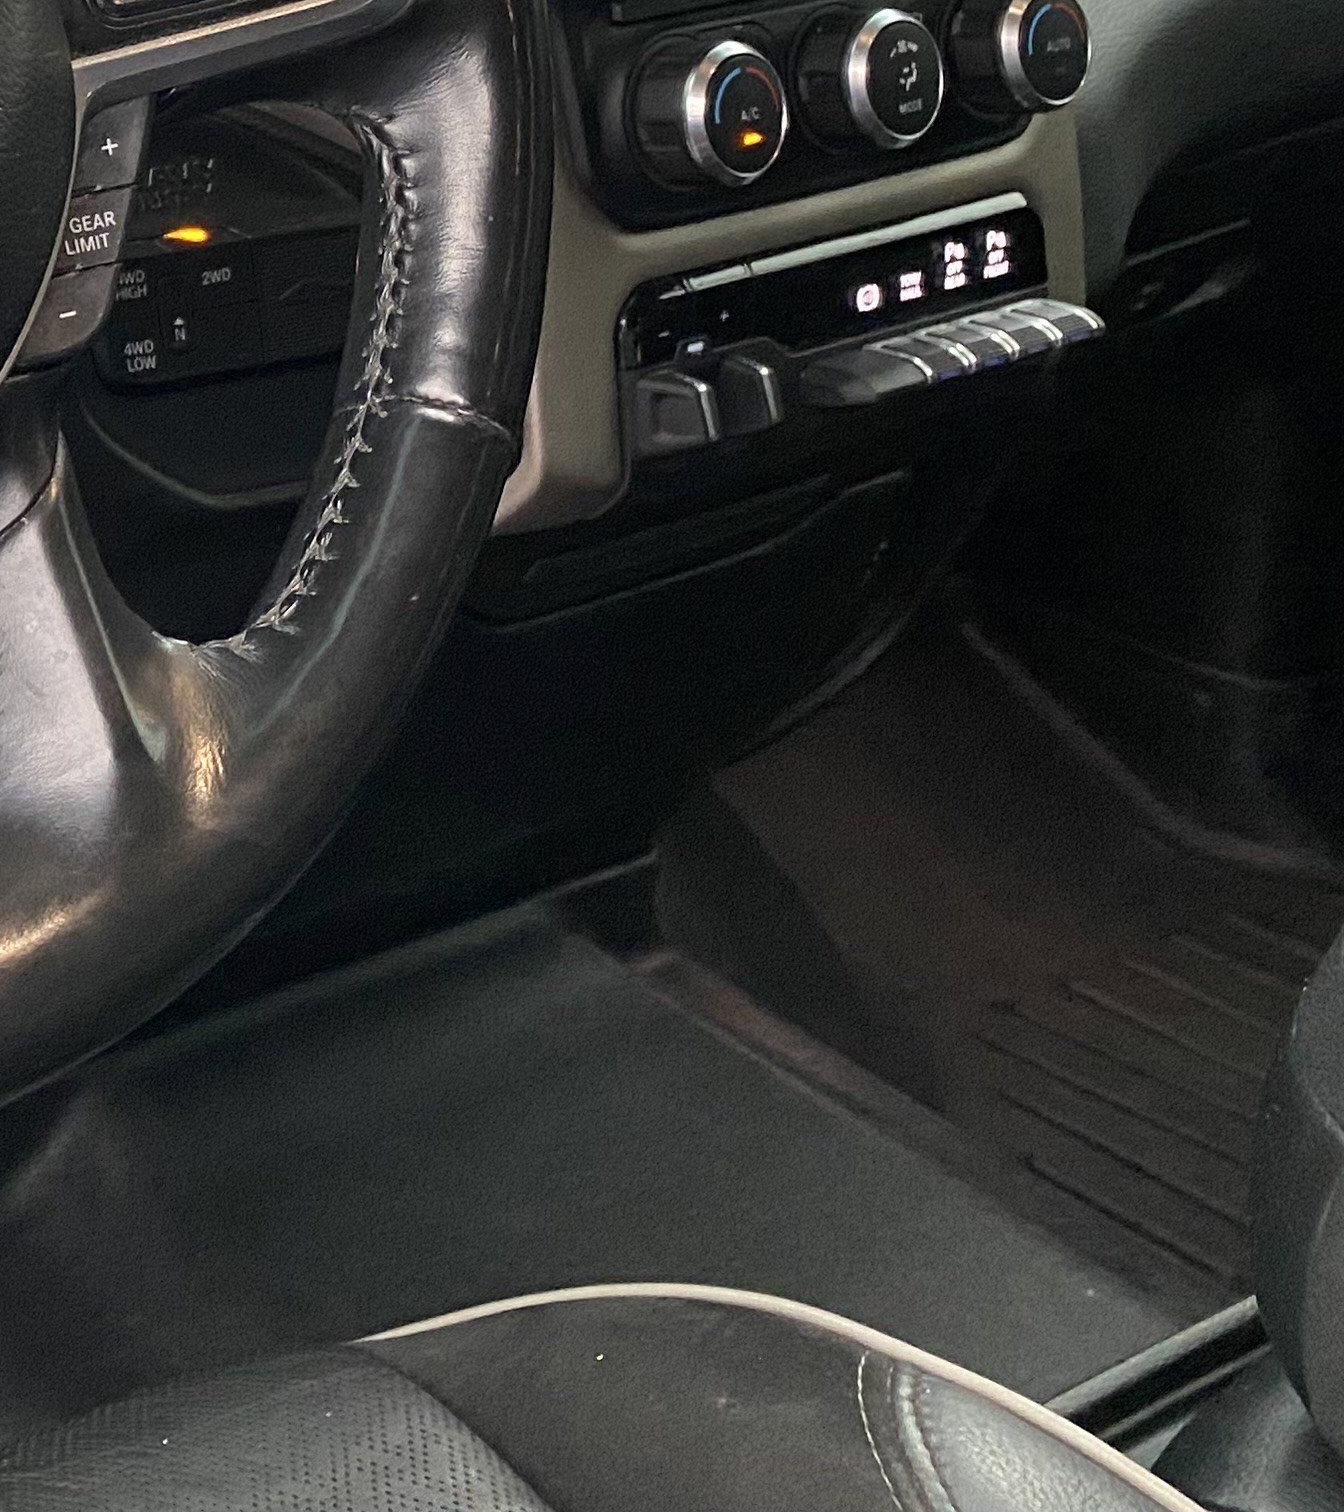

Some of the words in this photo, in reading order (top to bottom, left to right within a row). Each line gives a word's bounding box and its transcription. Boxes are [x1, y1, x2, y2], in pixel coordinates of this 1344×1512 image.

[69, 210, 117, 235] GEAR
[64, 232, 110, 256] LIMIT
[201, 266, 232, 286] 2WD
[123, 339, 154, 356] 4WD
[126, 355, 157, 373] LOW
